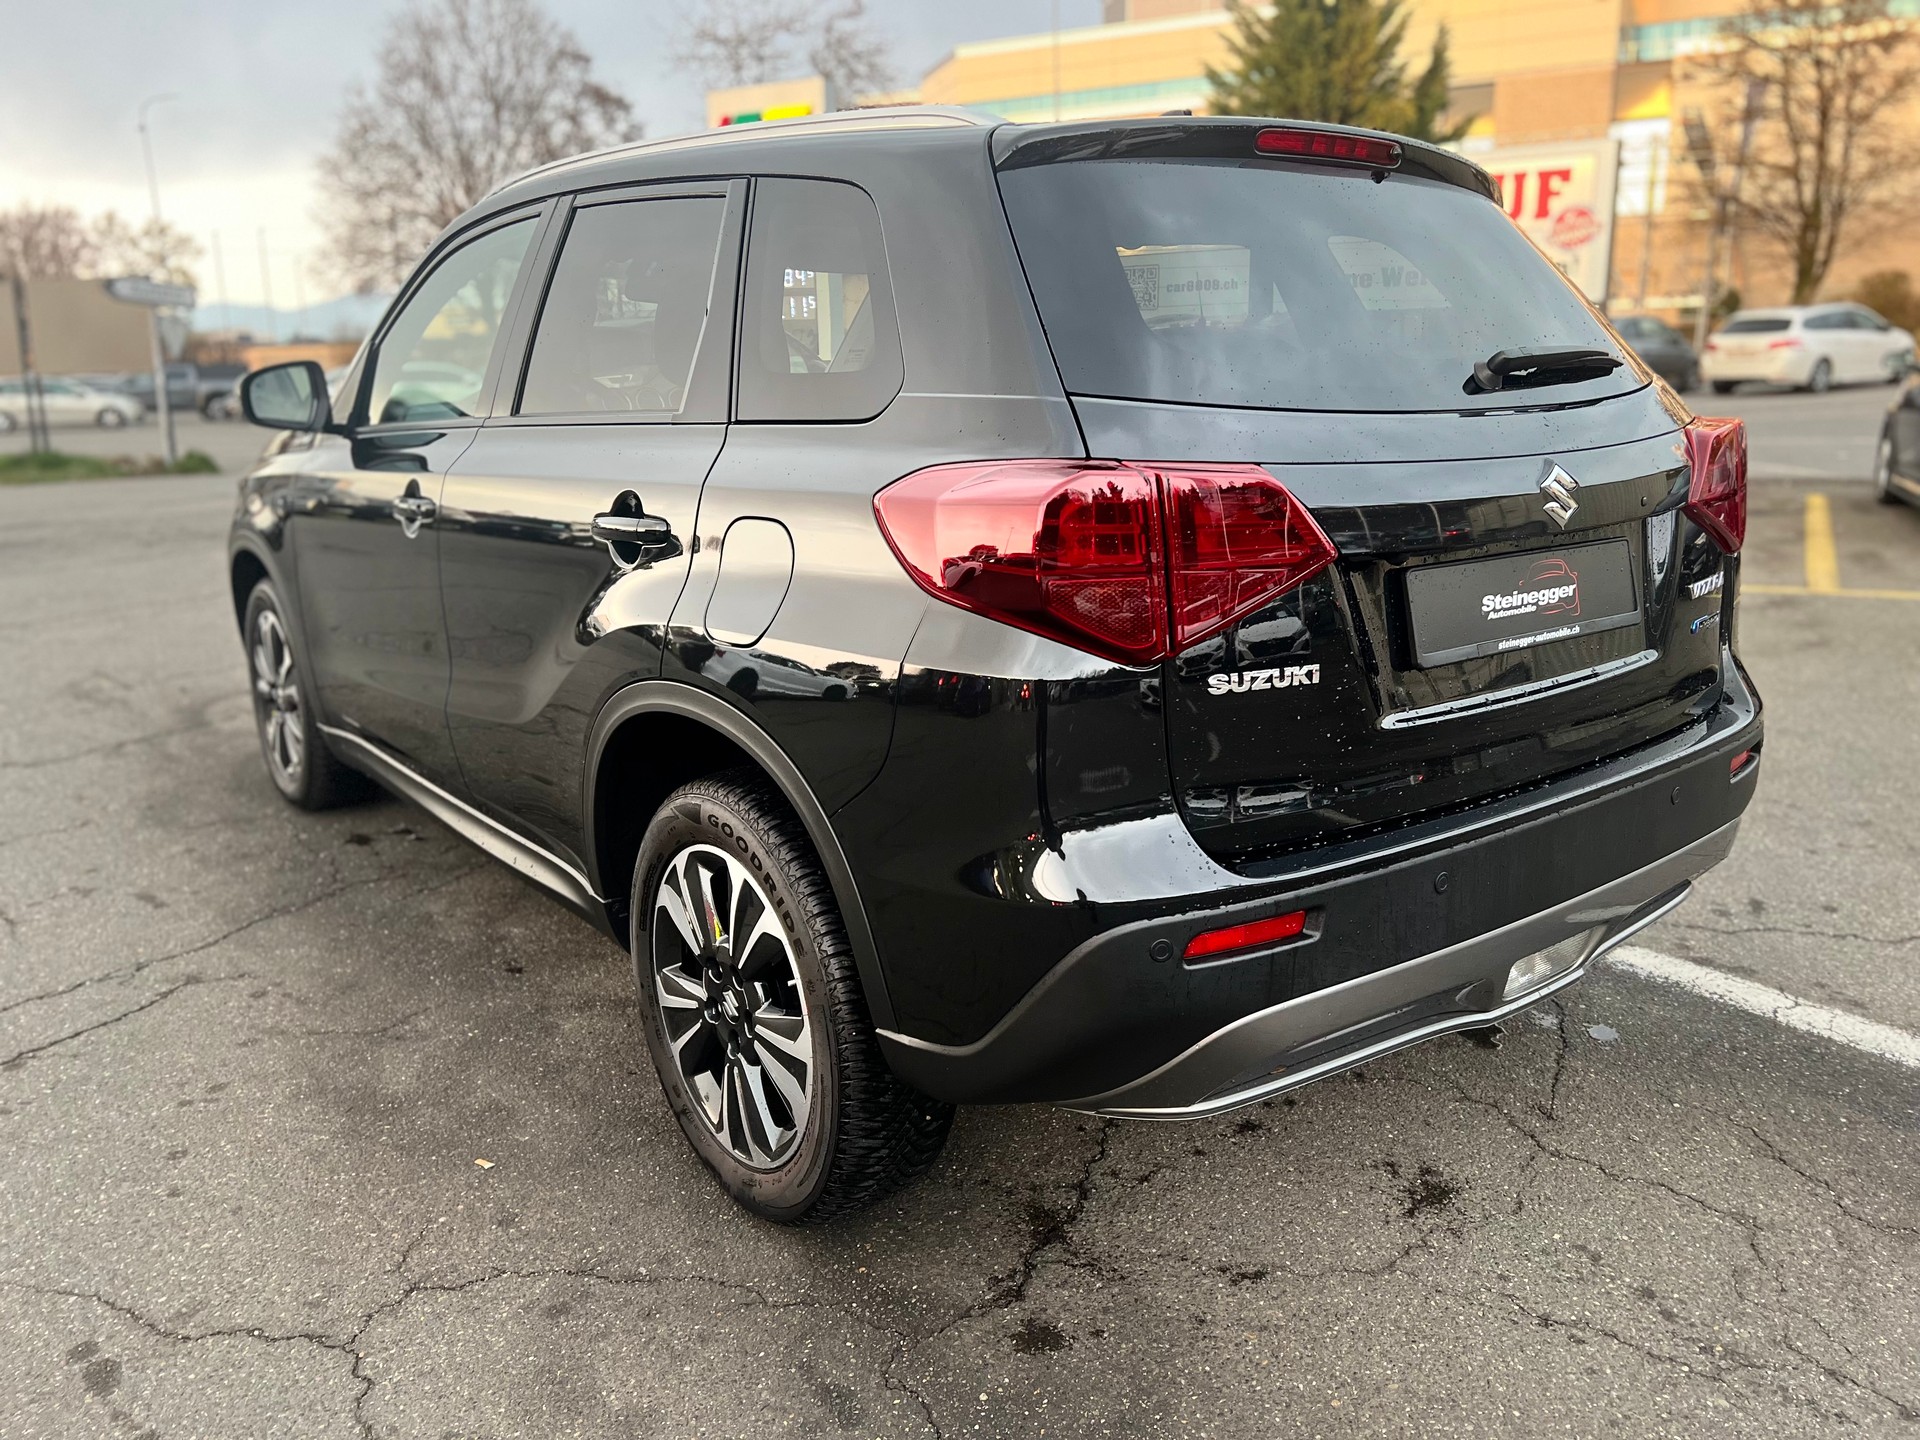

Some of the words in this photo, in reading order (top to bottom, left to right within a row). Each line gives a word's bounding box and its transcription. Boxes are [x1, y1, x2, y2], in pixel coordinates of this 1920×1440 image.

[1482, 583, 1577, 612] Steinegger
[1487, 605, 1537, 620] Automobile
[1498, 625, 1580, 650] steinegger-automobile.ch
[1207, 663, 1320, 695] SUZUKI
[707, 813, 805, 959] GOODRIDE
